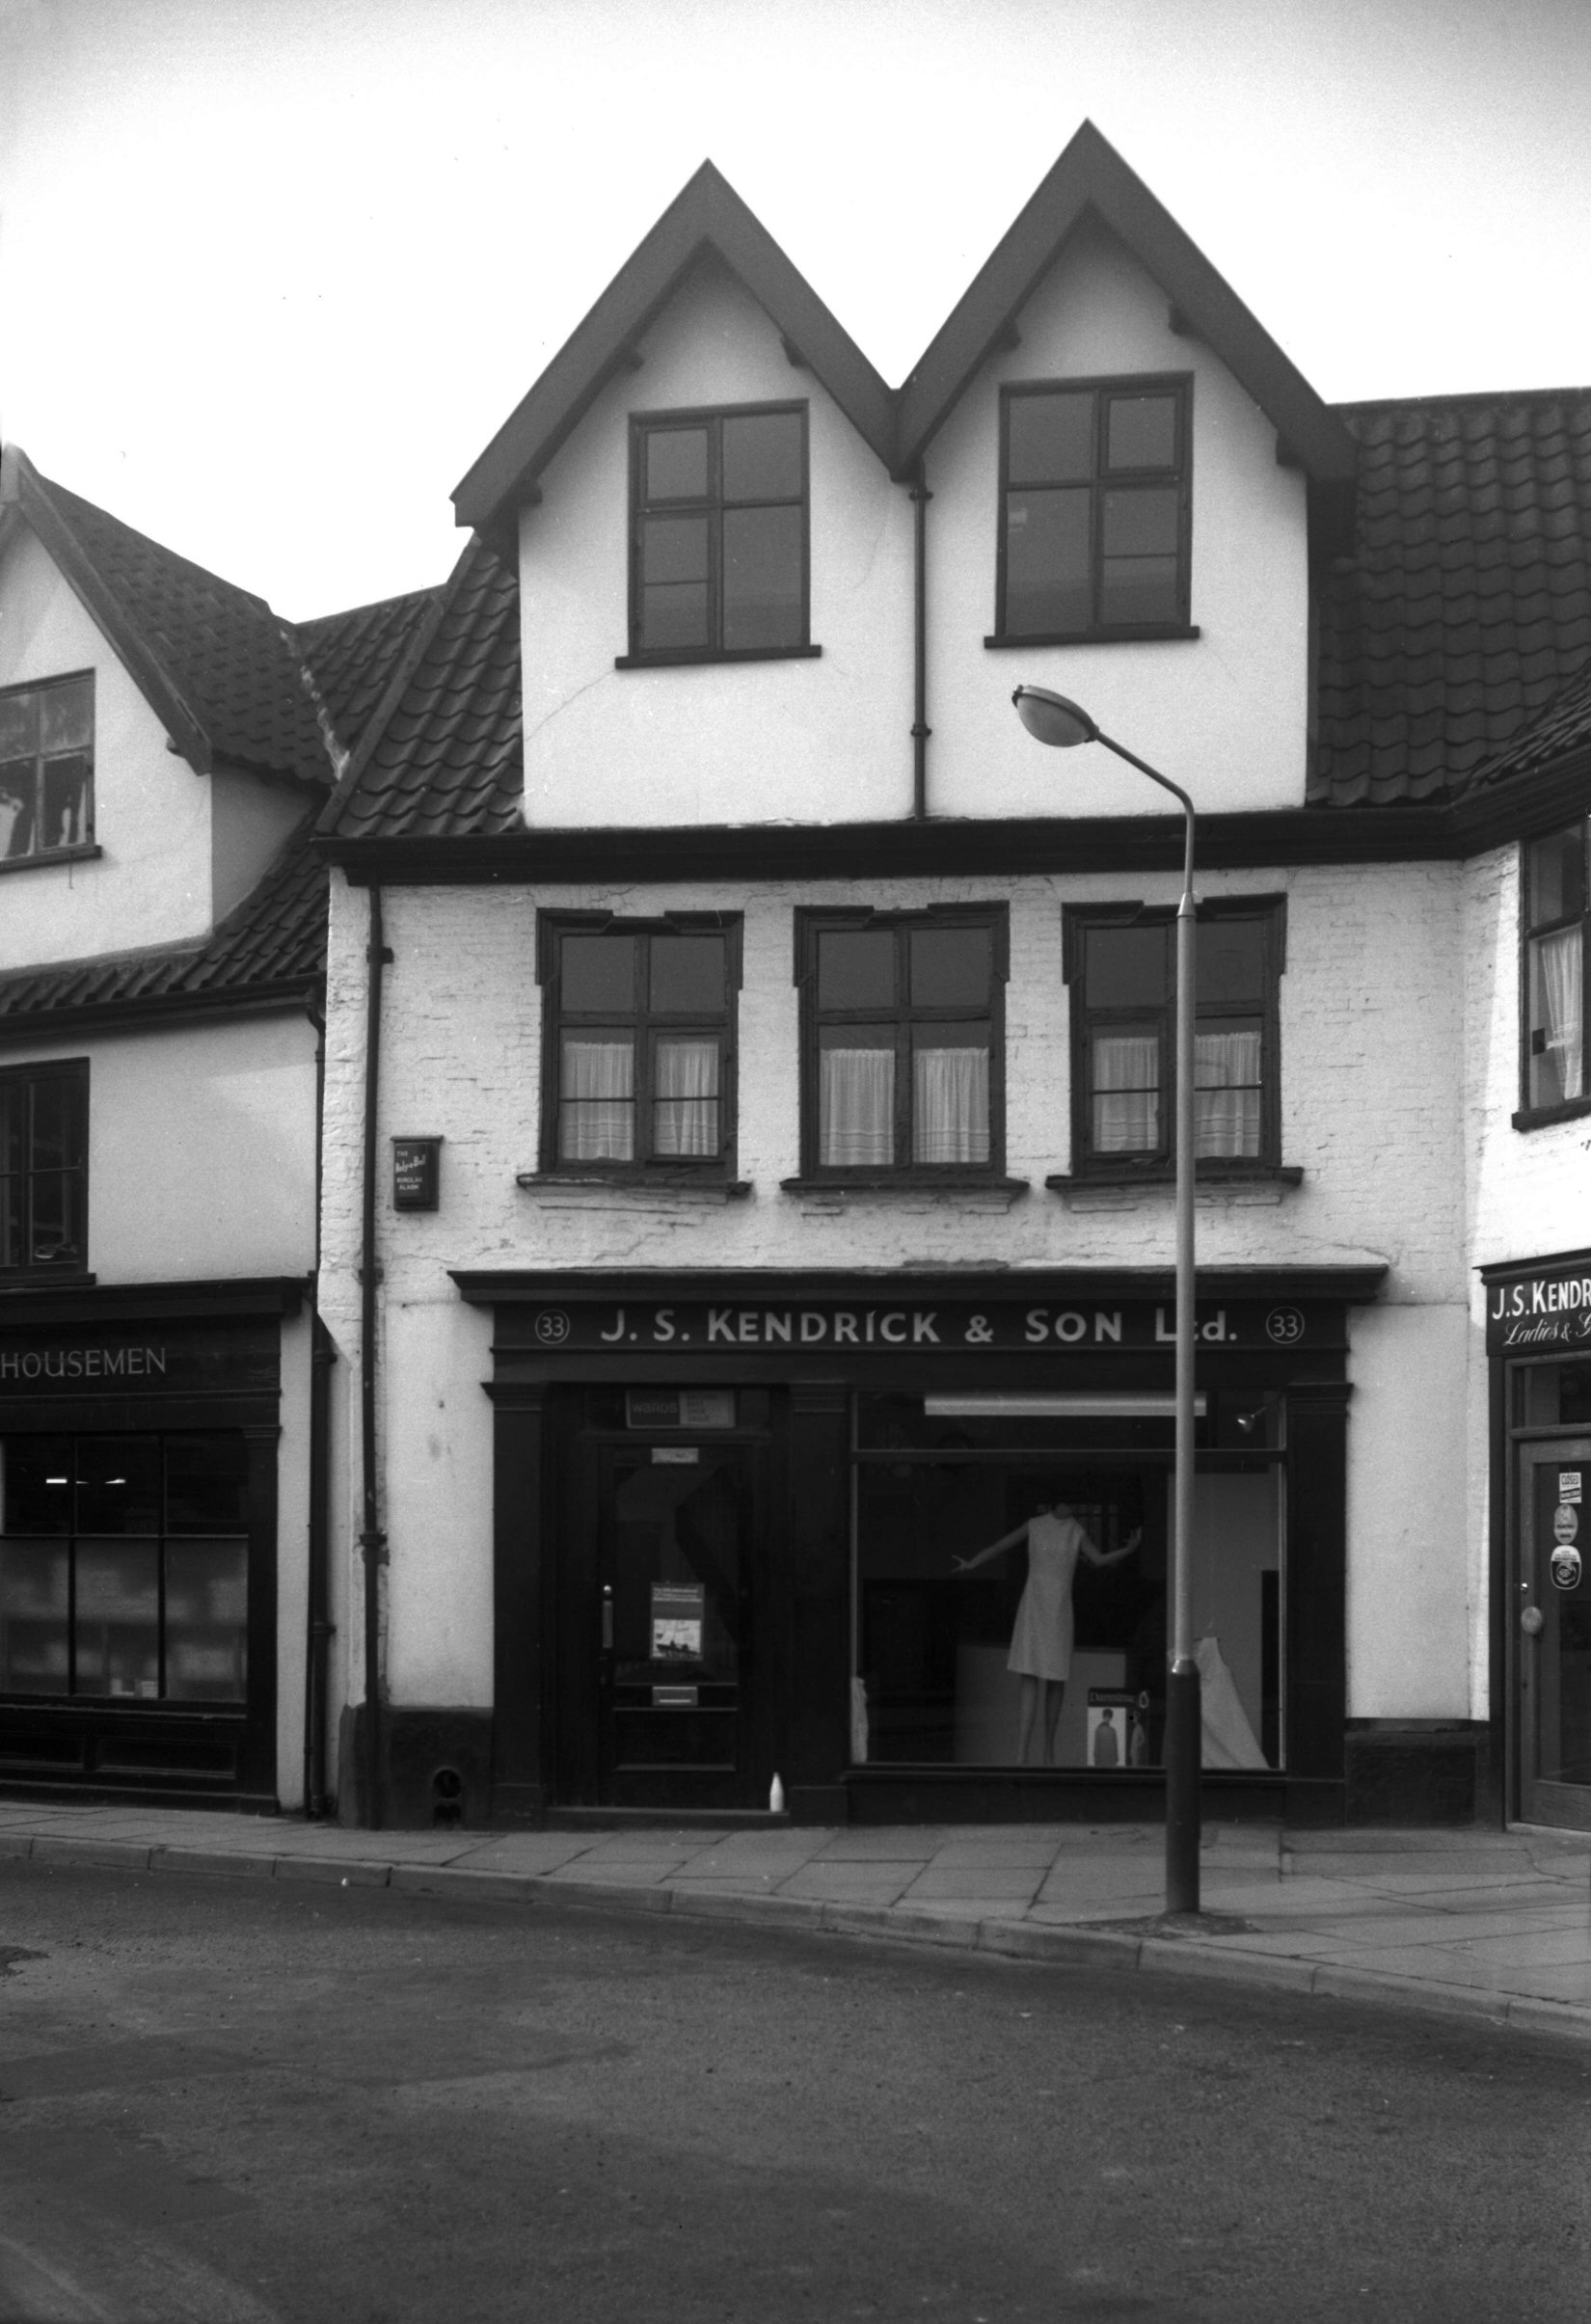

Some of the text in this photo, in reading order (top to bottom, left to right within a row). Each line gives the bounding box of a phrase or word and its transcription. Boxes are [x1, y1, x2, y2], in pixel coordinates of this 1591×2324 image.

[541, 1315, 565, 1338] 33
[708, 1309, 940, 1343] KENDRICK
[965, 1313, 994, 1342] &
[1025, 1309, 1122, 1342] SON
[1155, 1308, 1238, 1341] Ld.
[1273, 1314, 1299, 1338] 33
[1503, 1318, 1560, 1346] Ladies
[0, 1347, 166, 1379] HOUSEMEN
